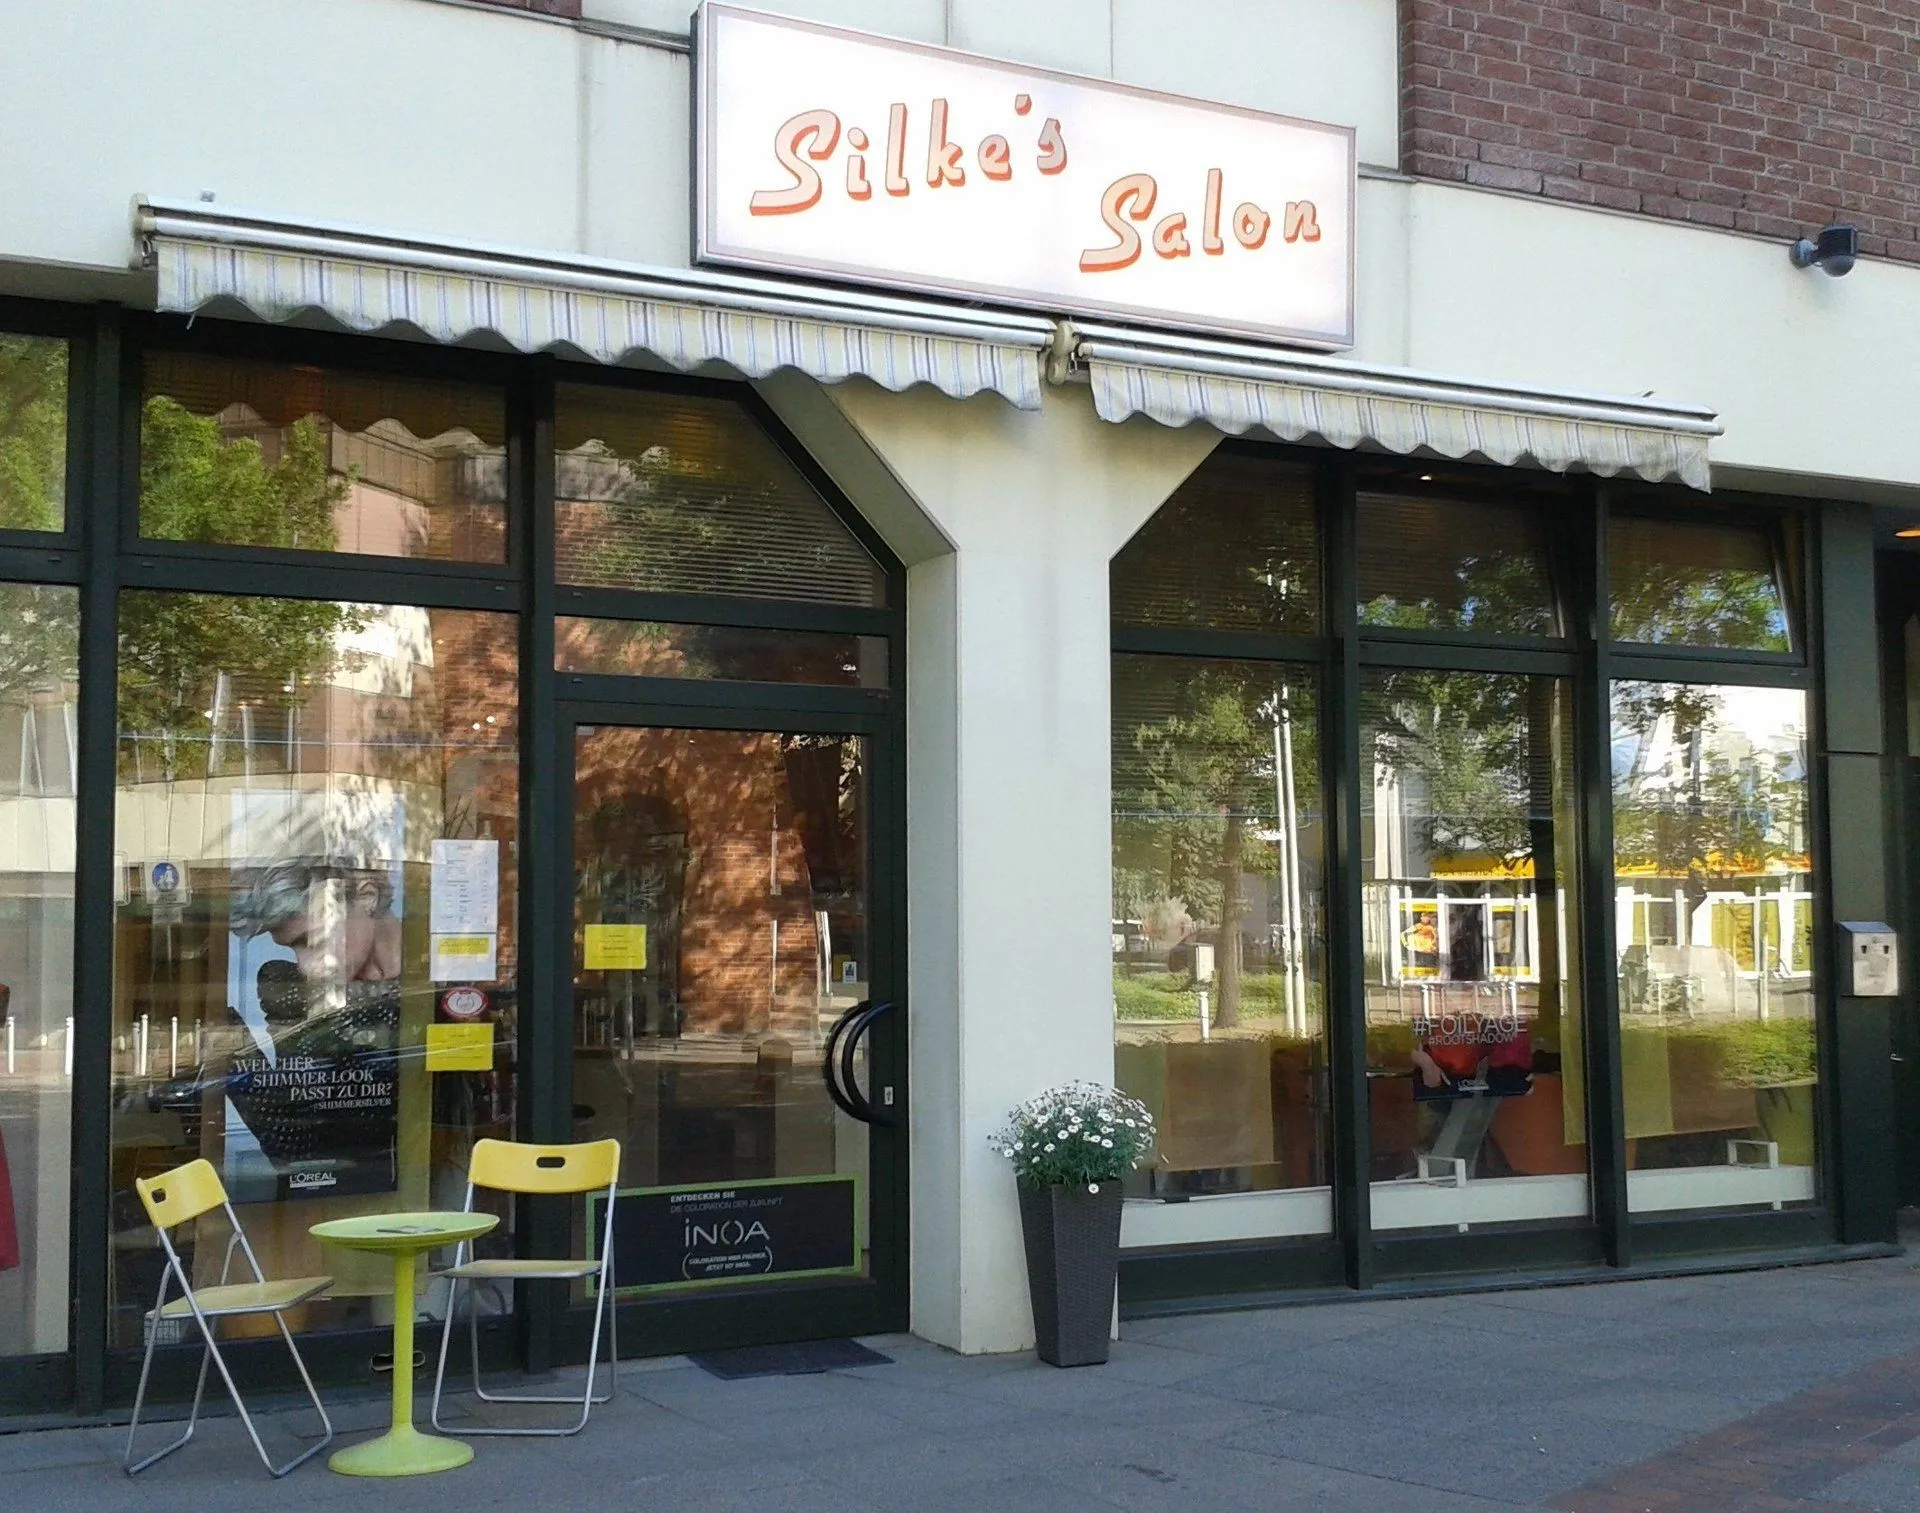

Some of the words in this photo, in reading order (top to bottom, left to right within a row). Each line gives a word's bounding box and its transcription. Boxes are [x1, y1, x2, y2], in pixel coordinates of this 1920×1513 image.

[750, 94, 1067, 216] Silke's
[1079, 168, 1321, 272] Salon
[1414, 1014, 1527, 1036] #FOILYAGE
[1428, 1033, 1513, 1045] #ROOTSHADOW
[235, 1056, 314, 1073] WELCHER
[253, 1068, 374, 1088] SHIMMER-LOOK
[290, 1086, 334, 1101] PASST
[337, 1084, 358, 1098] ZU
[361, 1082, 391, 1097] DIR?
